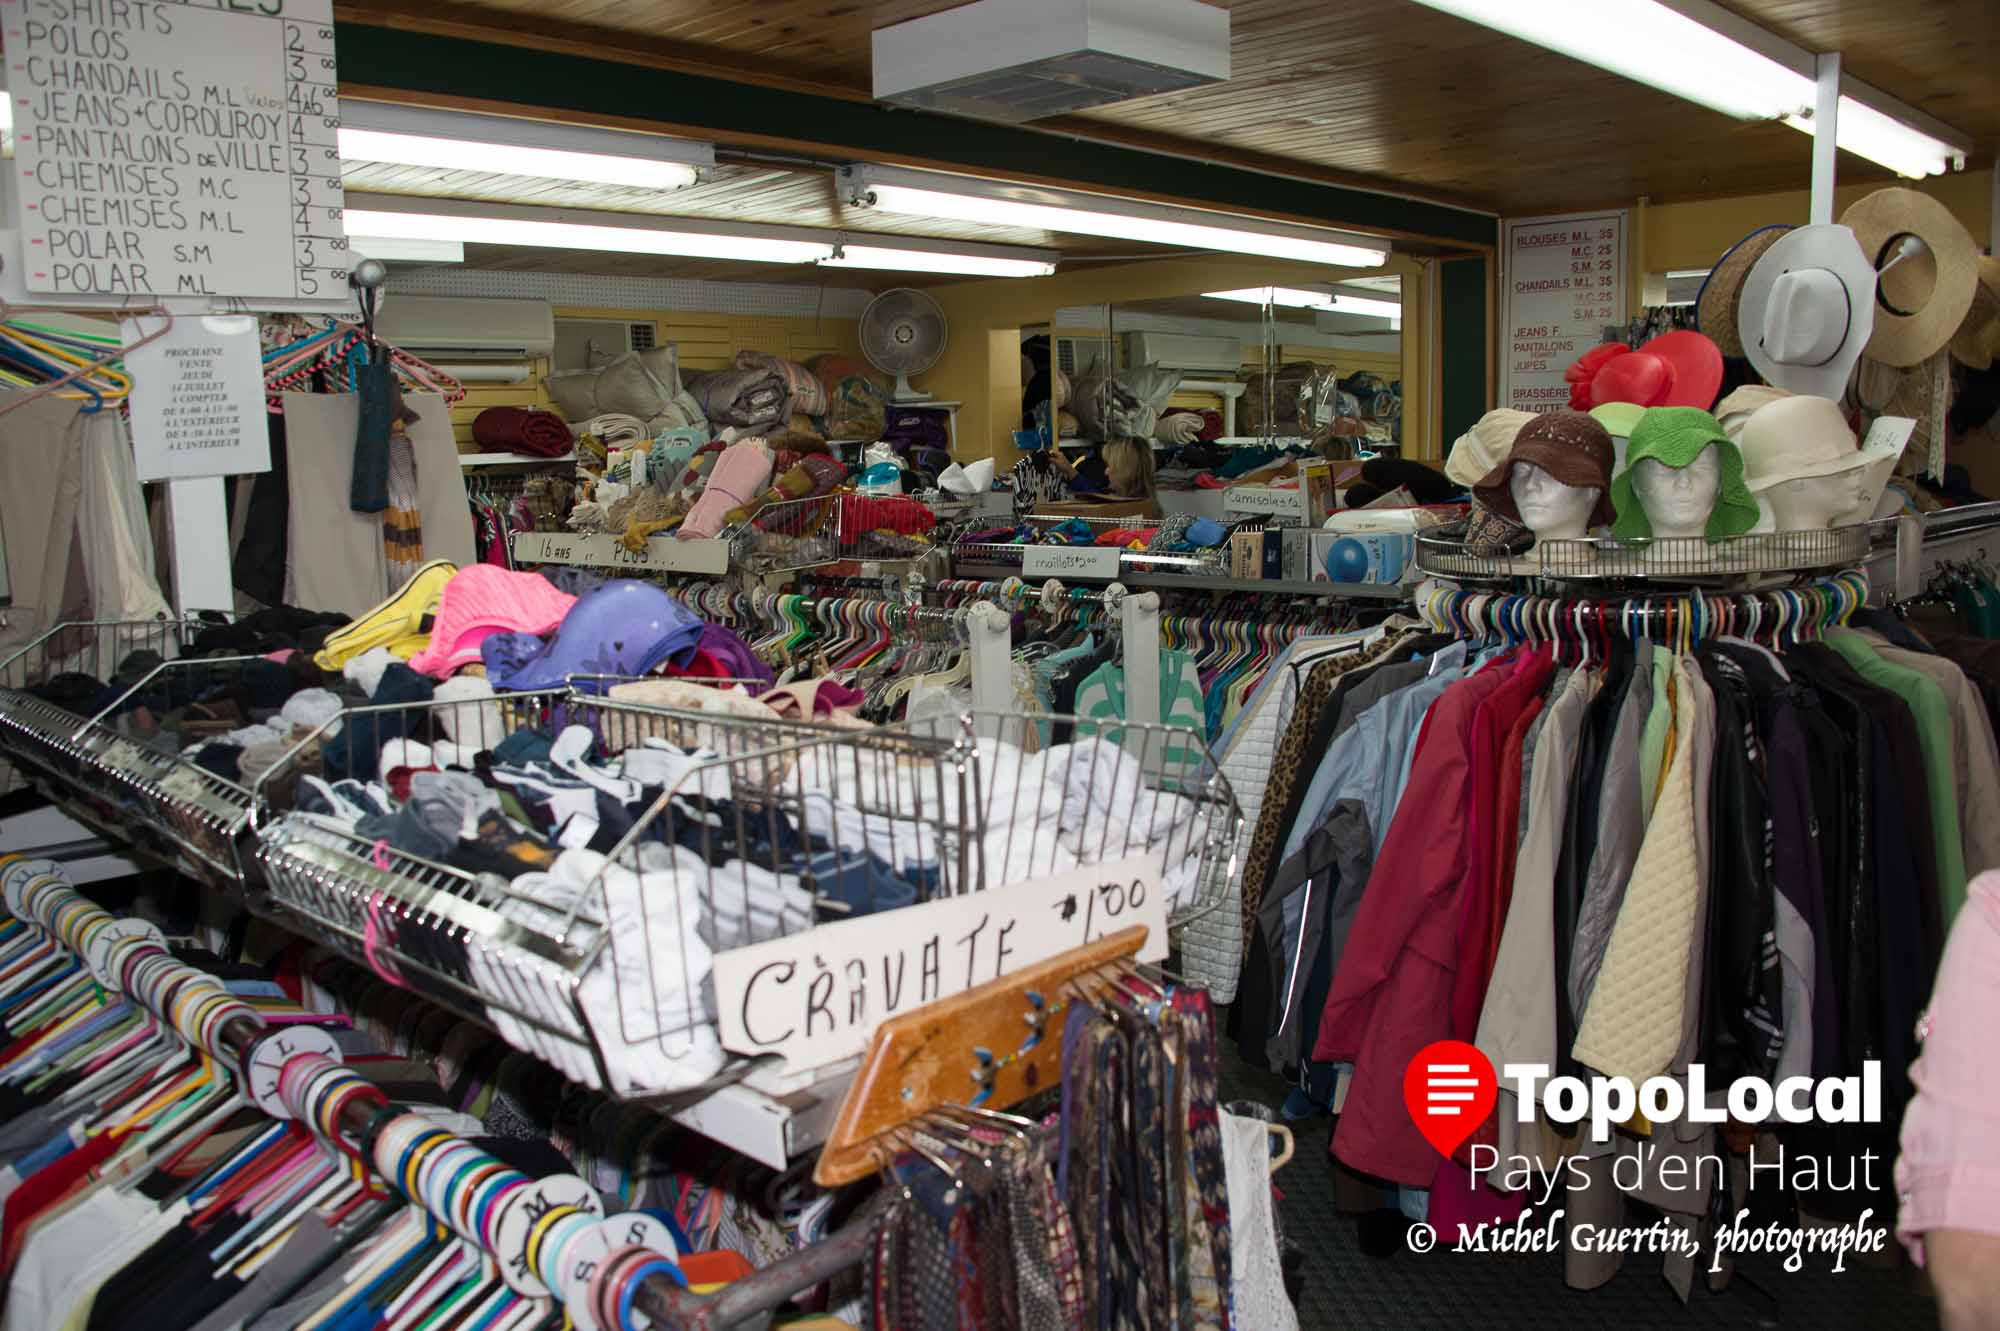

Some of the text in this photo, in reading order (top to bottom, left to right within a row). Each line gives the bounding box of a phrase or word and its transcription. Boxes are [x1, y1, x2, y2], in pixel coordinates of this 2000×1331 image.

[25, 20, 129, 61] POLOS
[288, 54, 307, 82] 3
[27, 56, 190, 101] CHANDAILS
[36, 126, 190, 165] PANTALONS
[215, 142, 286, 173] VILLE
[293, 148, 309, 176] 3
[36, 160, 179, 196] CHEMISES
[294, 178, 312, 205] 3
[40, 195, 188, 230] CHEMISES
[295, 206, 311, 232] 4
[1517, 232, 1567, 246] BLOUSES
[48, 229, 145, 260] POLAR
[298, 239, 315, 268] 3
[52, 263, 153, 293] POLAR
[300, 269, 319, 295] 5
[1515, 278, 1570, 292] CHANDAILS
[1514, 327, 1548, 338] JEANS
[164, 347, 224, 358] PROCHAINE
[1513, 340, 1574, 353] PANTALONS
[179, 360, 213, 368] VENTE
[1514, 360, 1547, 371] JUPES
[182, 382, 225, 392] JUILLET
[179, 393, 228, 403] COMPTER
[540, 537, 552, 558] 16
